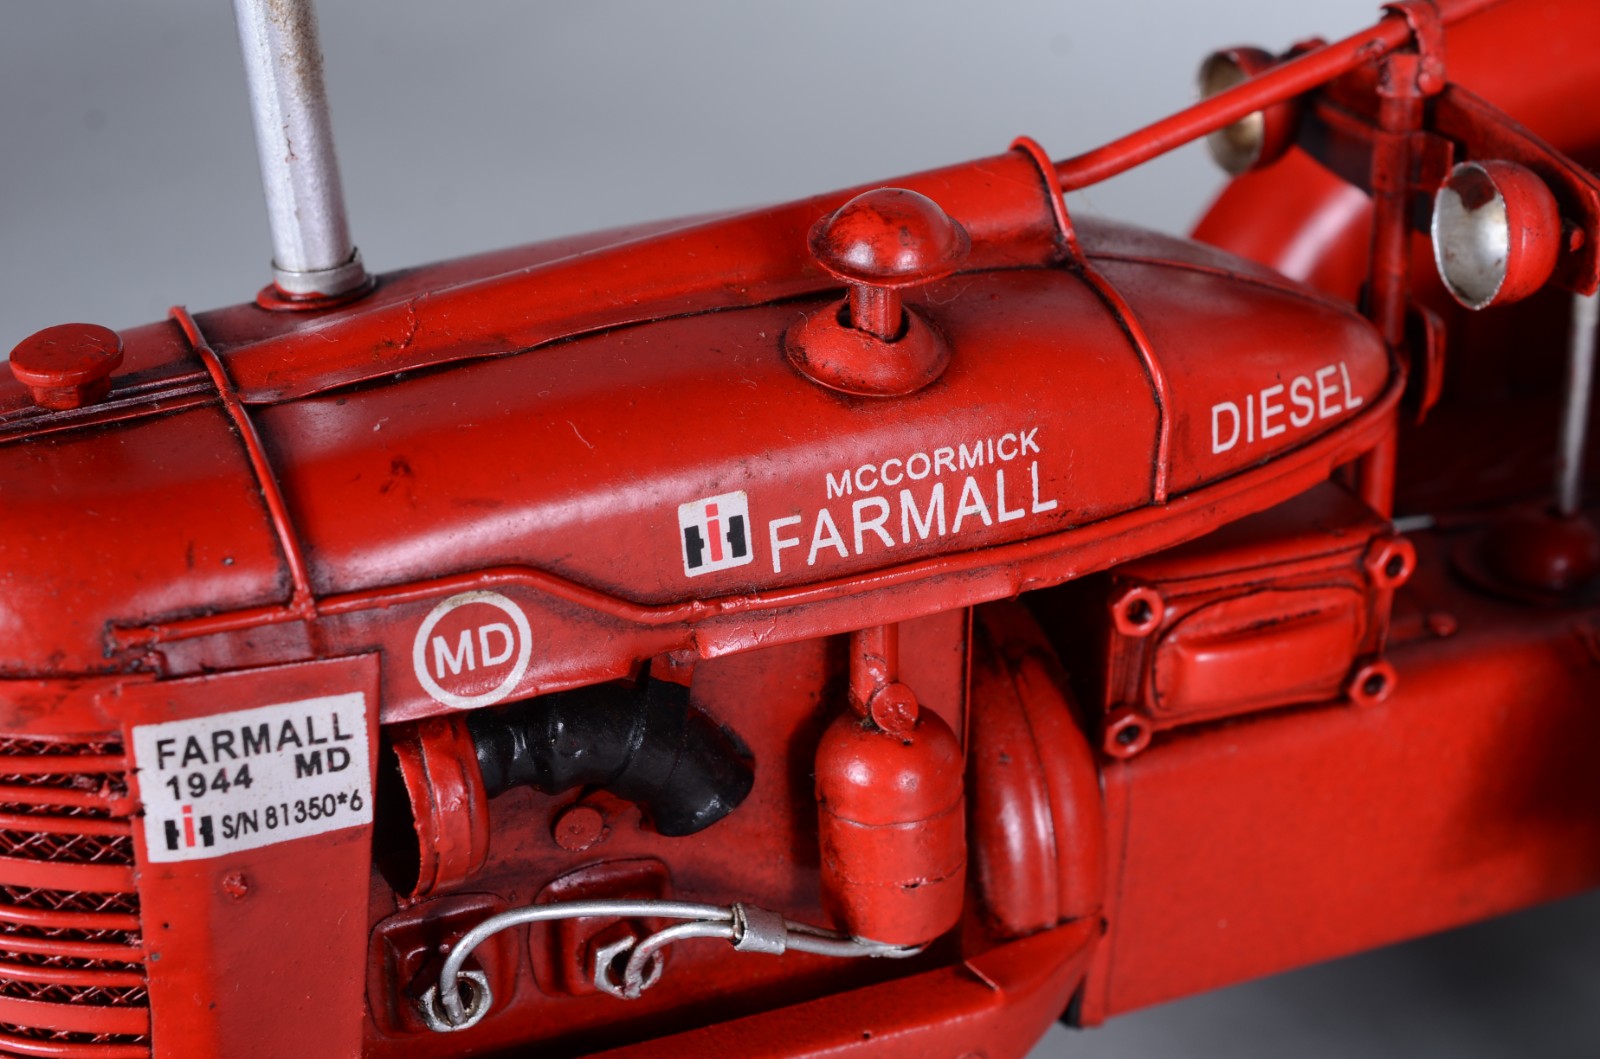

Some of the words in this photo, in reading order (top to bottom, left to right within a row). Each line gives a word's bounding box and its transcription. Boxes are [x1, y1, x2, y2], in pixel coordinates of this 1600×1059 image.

[1211, 361, 1363, 455] DIESEL
[825, 427, 1040, 499] MCCORMICK
[769, 461, 1057, 573] FARMALL
[432, 622, 515, 679] MD
[157, 712, 353, 770] FARMALL
[166, 763, 253, 800] 1944
[295, 747, 351, 779] MD
[222, 811, 258, 839] S/N
